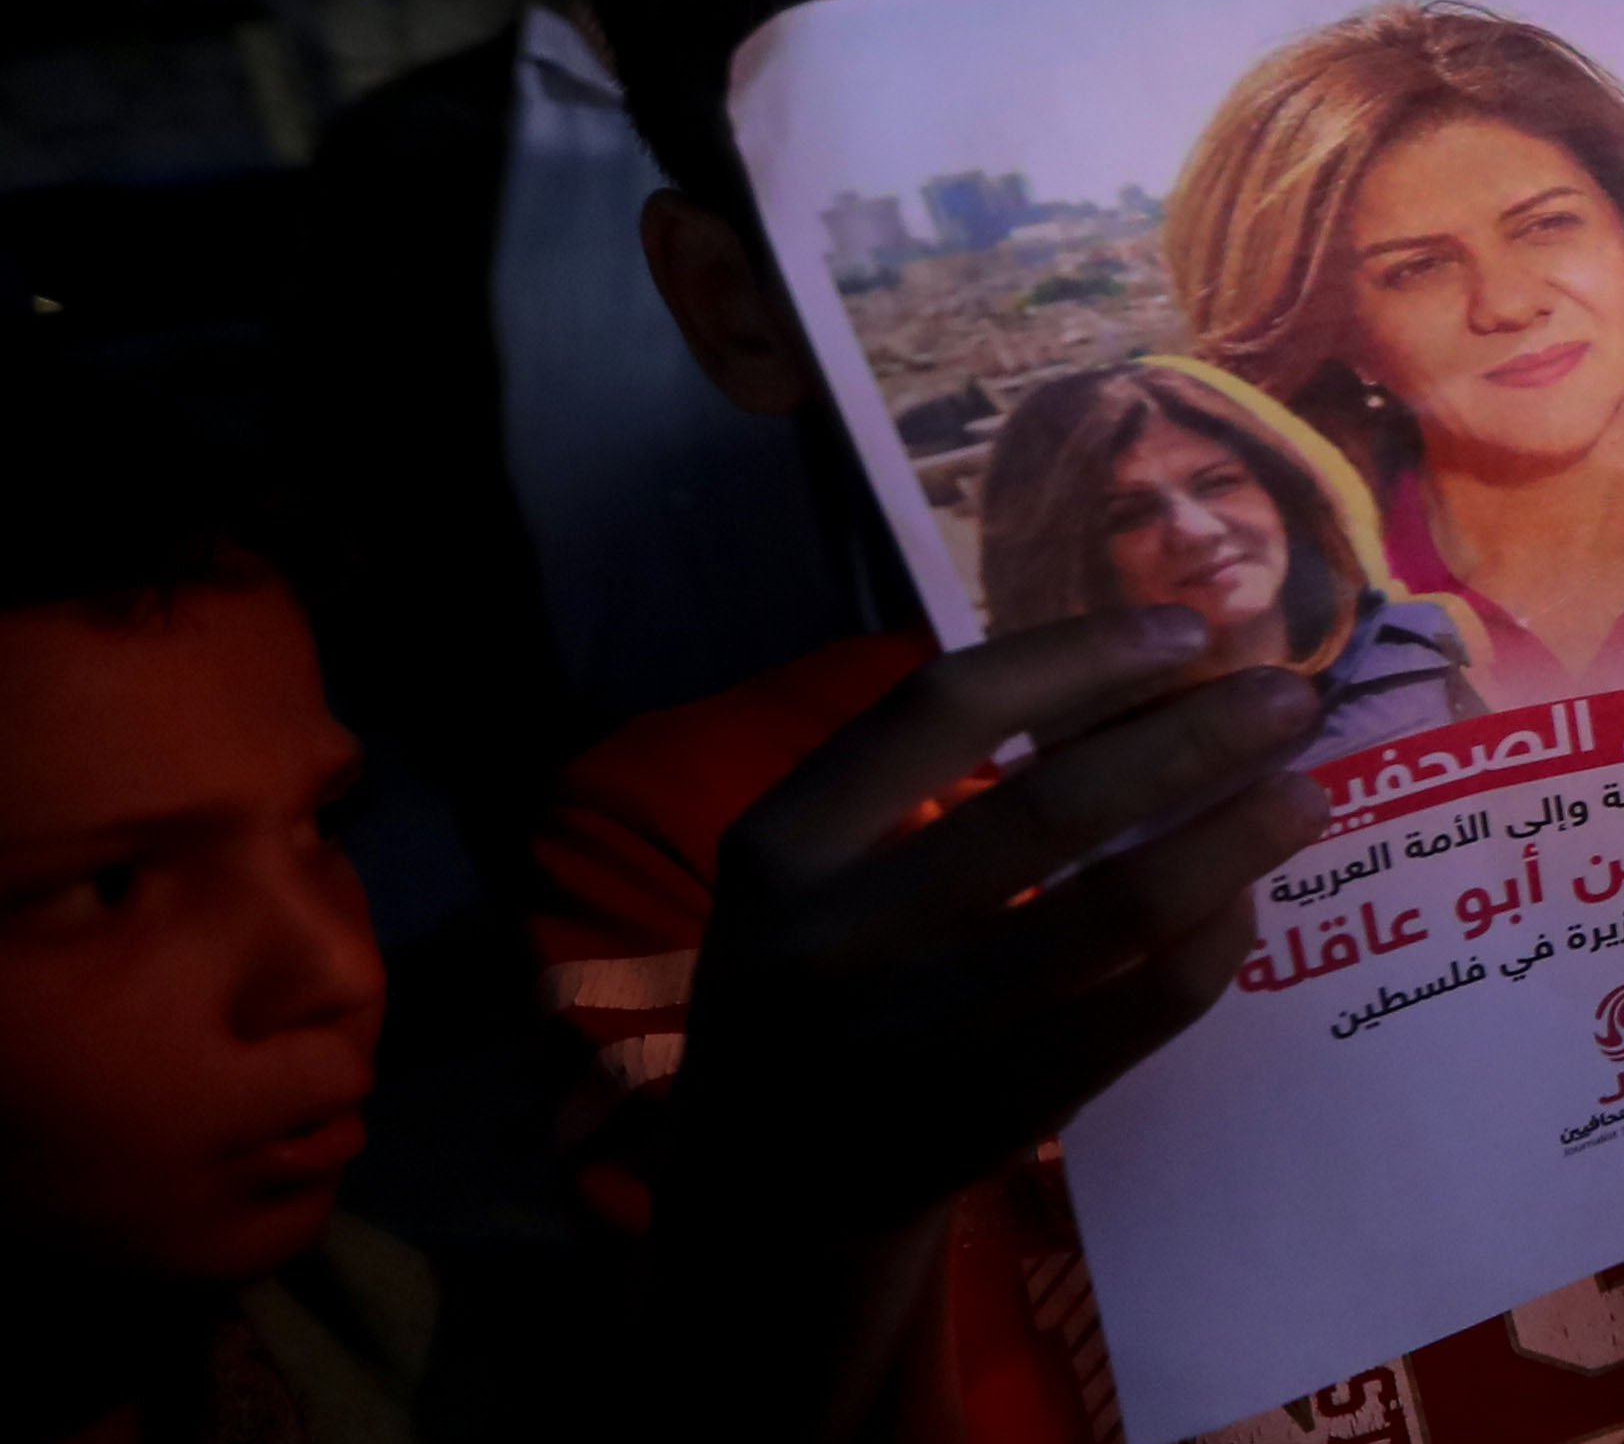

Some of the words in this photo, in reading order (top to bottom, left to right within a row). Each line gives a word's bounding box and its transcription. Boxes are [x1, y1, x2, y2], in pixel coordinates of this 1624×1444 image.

[1407, 812, 1489, 860] الأمة
[1508, 796, 1587, 838] وإلى
[1273, 844, 1390, 905] العربية
[1459, 844, 1543, 939] أبو
[1240, 900, 1426, 993] عاقلة
[1502, 935, 1553, 984] في
[1333, 958, 1485, 1038] فلسطين
